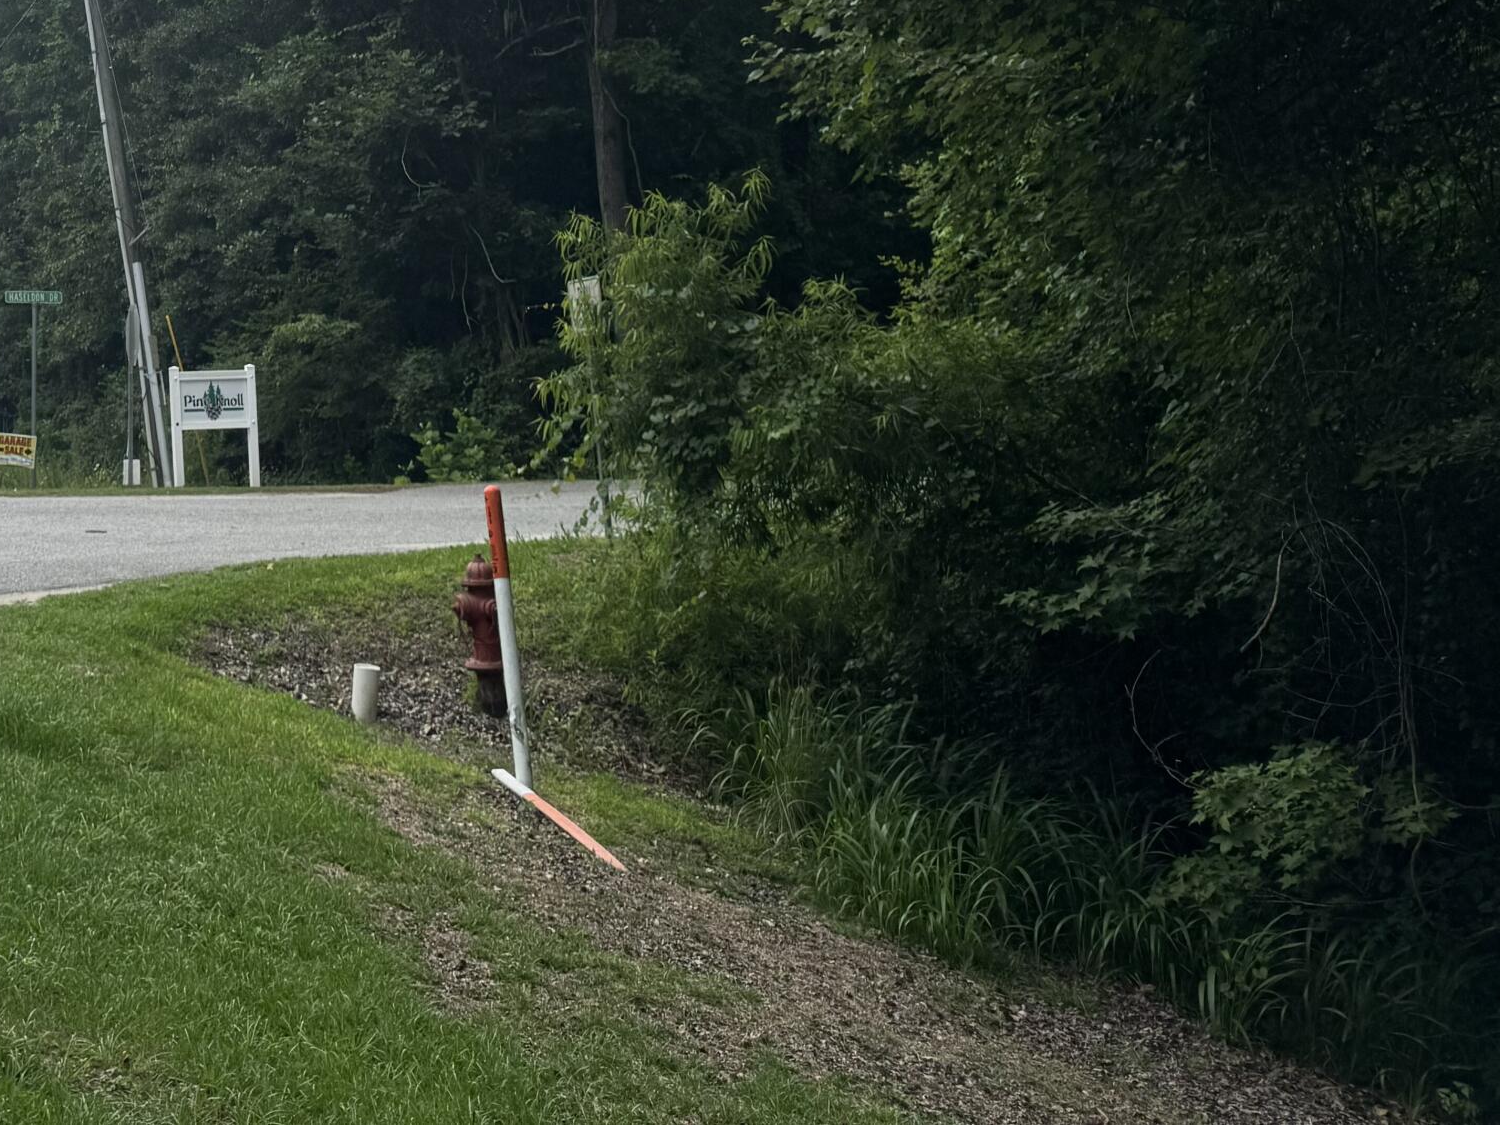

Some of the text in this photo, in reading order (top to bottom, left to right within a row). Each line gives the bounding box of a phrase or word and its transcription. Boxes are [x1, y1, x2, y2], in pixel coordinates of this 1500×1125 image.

[49, 292, 59, 302] DR
[0, 435, 32, 447] GARAGE
[4, 446, 24, 455] SALE
